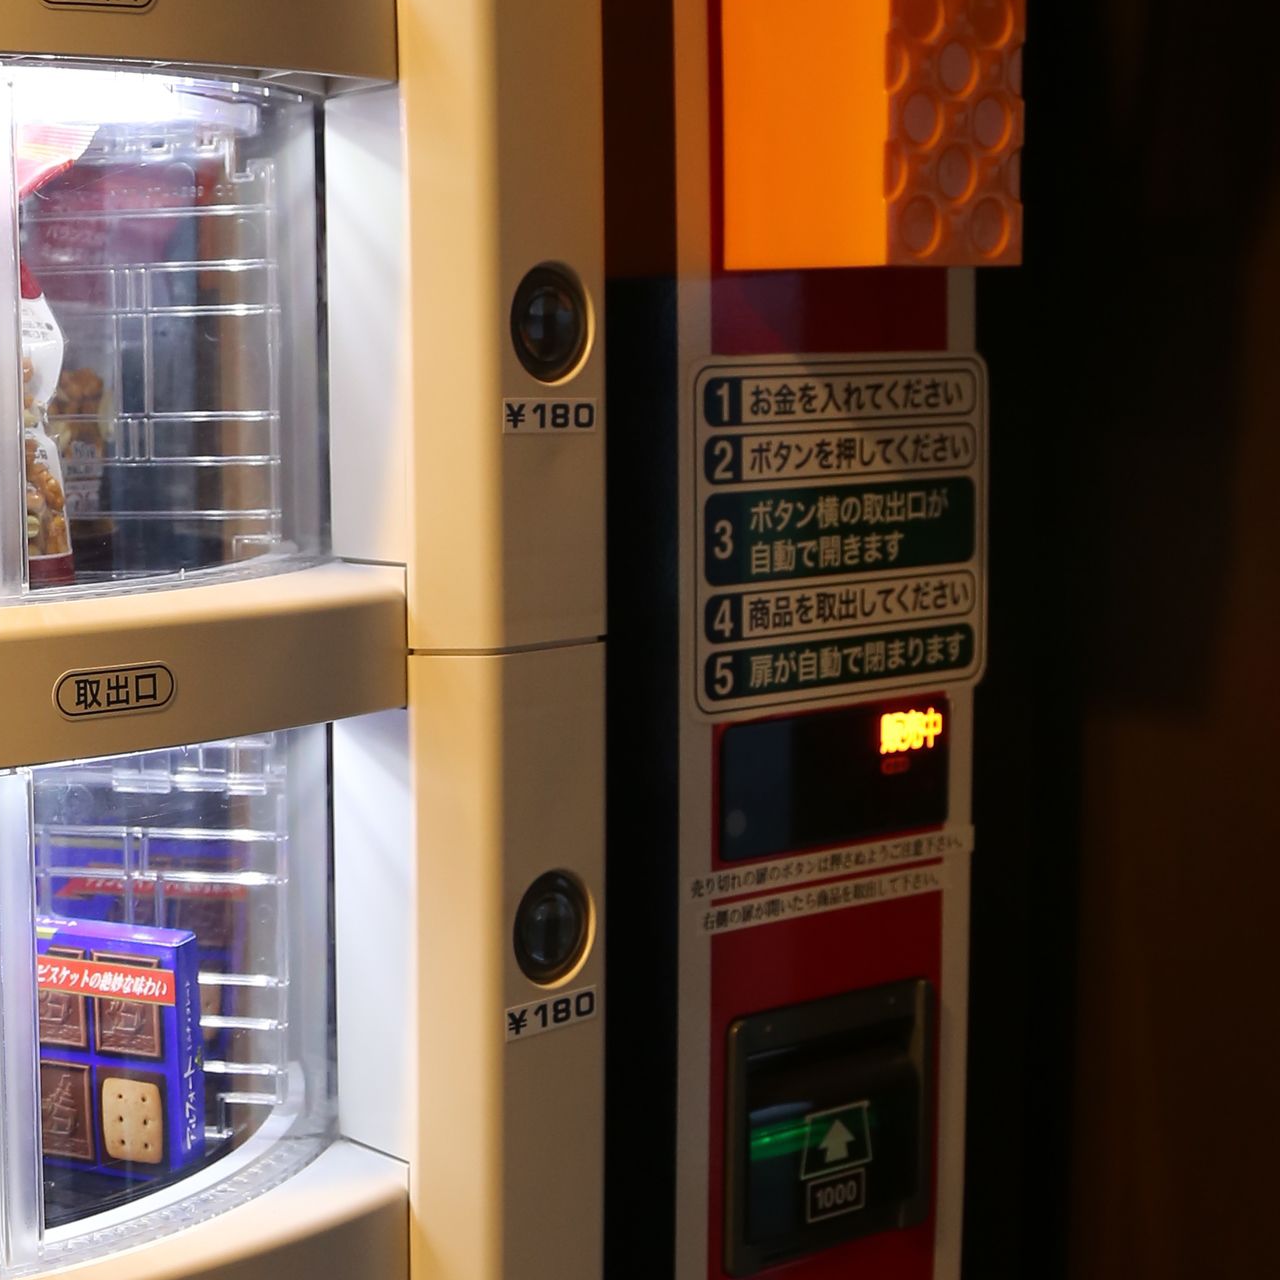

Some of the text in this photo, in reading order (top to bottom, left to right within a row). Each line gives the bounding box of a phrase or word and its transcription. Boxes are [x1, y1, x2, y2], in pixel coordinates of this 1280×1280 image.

[505, 403, 595, 429] ¥180
[718, 379, 964, 421] 1 お金を入れてください
[713, 431, 969, 481] 2 ボタンを押してください
[713, 487, 949, 561] 3 ボタン横の取出口が
[749, 531, 904, 575] 自動で開きます
[713, 582, 969, 638] 4 商品を取出してください
[713, 631, 966, 696] 5 扉が自動で閉まります
[75, 672, 159, 710] 取出口
[507, 991, 595, 1035] ¥180
[815, 1180, 857, 1211] 1000
